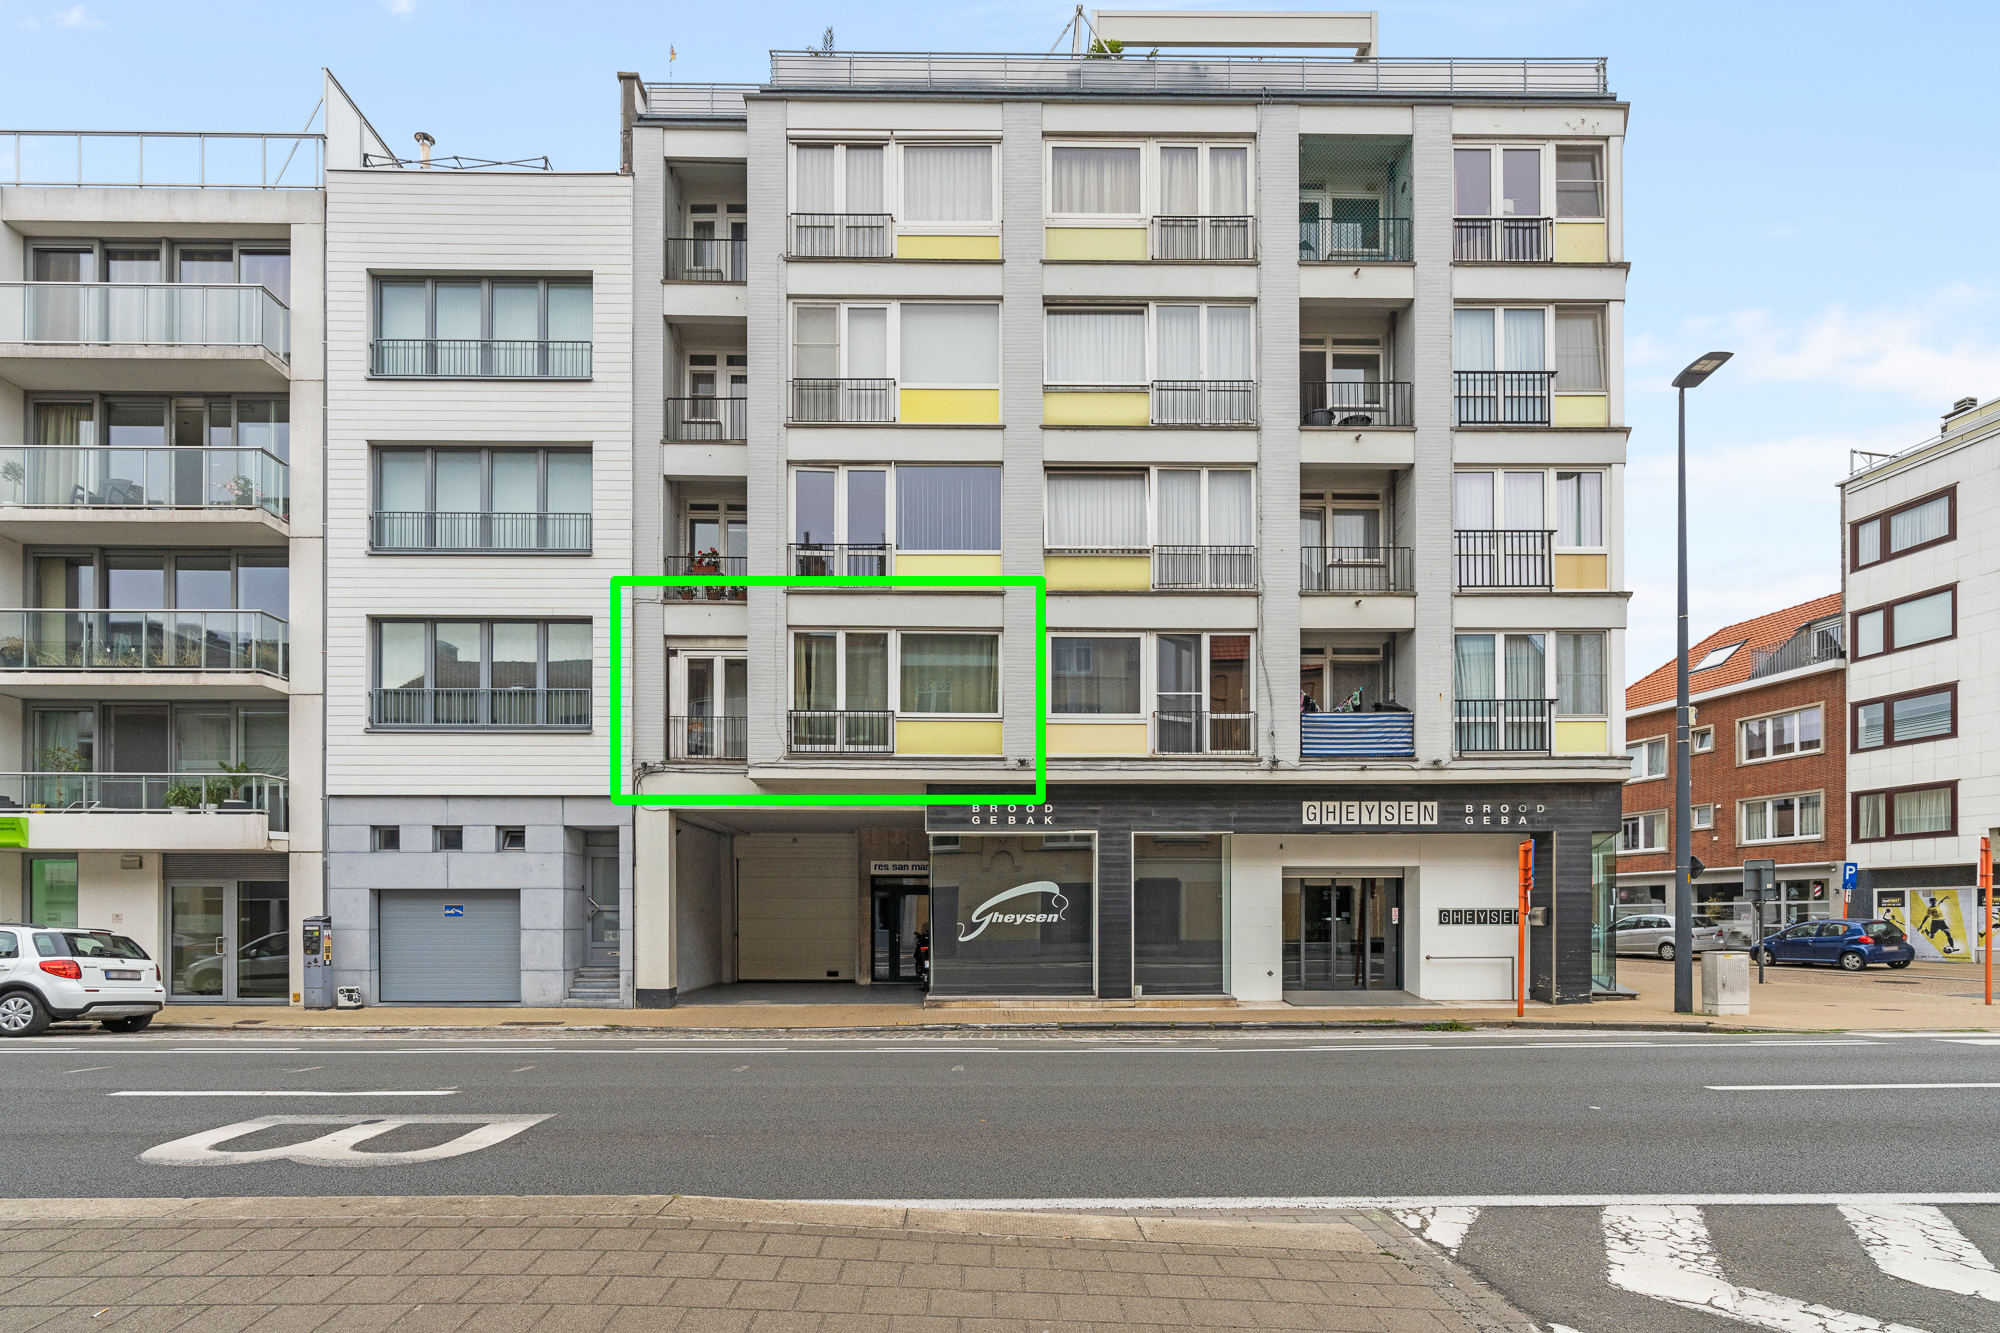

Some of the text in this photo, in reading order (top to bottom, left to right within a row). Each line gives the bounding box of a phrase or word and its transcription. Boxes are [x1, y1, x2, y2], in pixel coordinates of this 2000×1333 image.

[972, 805, 1053, 813] BROOD
[1306, 804, 1434, 821] GHEYSEN
[1465, 804, 1545, 813] BROOD
[971, 816, 1053, 825] GEBAK
[892, 863, 909, 871] san
[957, 881, 1069, 942] Gheysen
